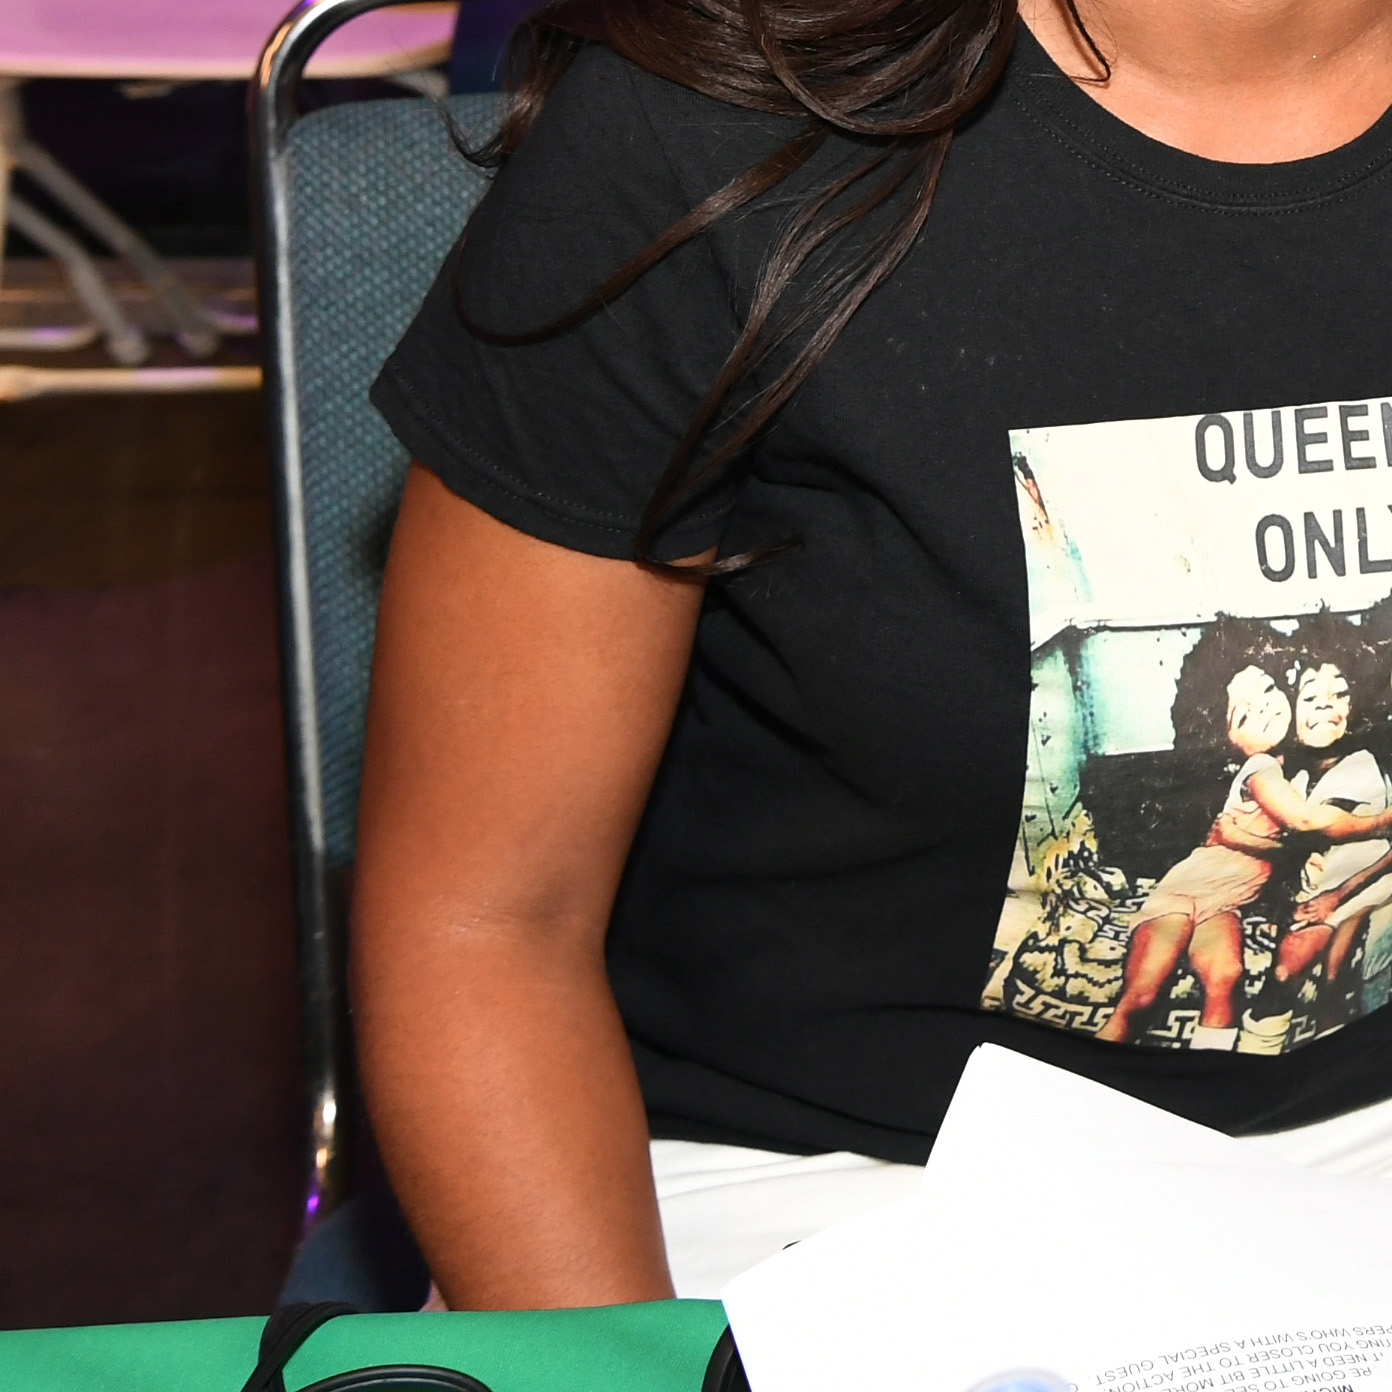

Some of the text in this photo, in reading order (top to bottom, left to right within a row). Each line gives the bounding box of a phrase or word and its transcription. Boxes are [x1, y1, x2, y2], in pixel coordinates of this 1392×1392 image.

[1250, 1333, 1294, 1347] WITH
[1296, 1328, 1351, 1341] WHO'S
[1234, 1339, 1245, 1350] A
[1318, 1341, 1354, 1353] YOU
[1158, 1342, 1231, 1365] SPECIAL
[1246, 1344, 1314, 1363] CLOSER
[1322, 1353, 1367, 1367] NEED
[1219, 1355, 1244, 1368] TO
[1307, 1358, 1317, 1368] A
[1179, 1361, 1216, 1378] THE
[1248, 1360, 1304, 1379] LITTLE
[1220, 1370, 1245, 1386] BIT
[1264, 1378, 1289, 1391] TO
[1291, 1369, 1346, 1386] GOING
